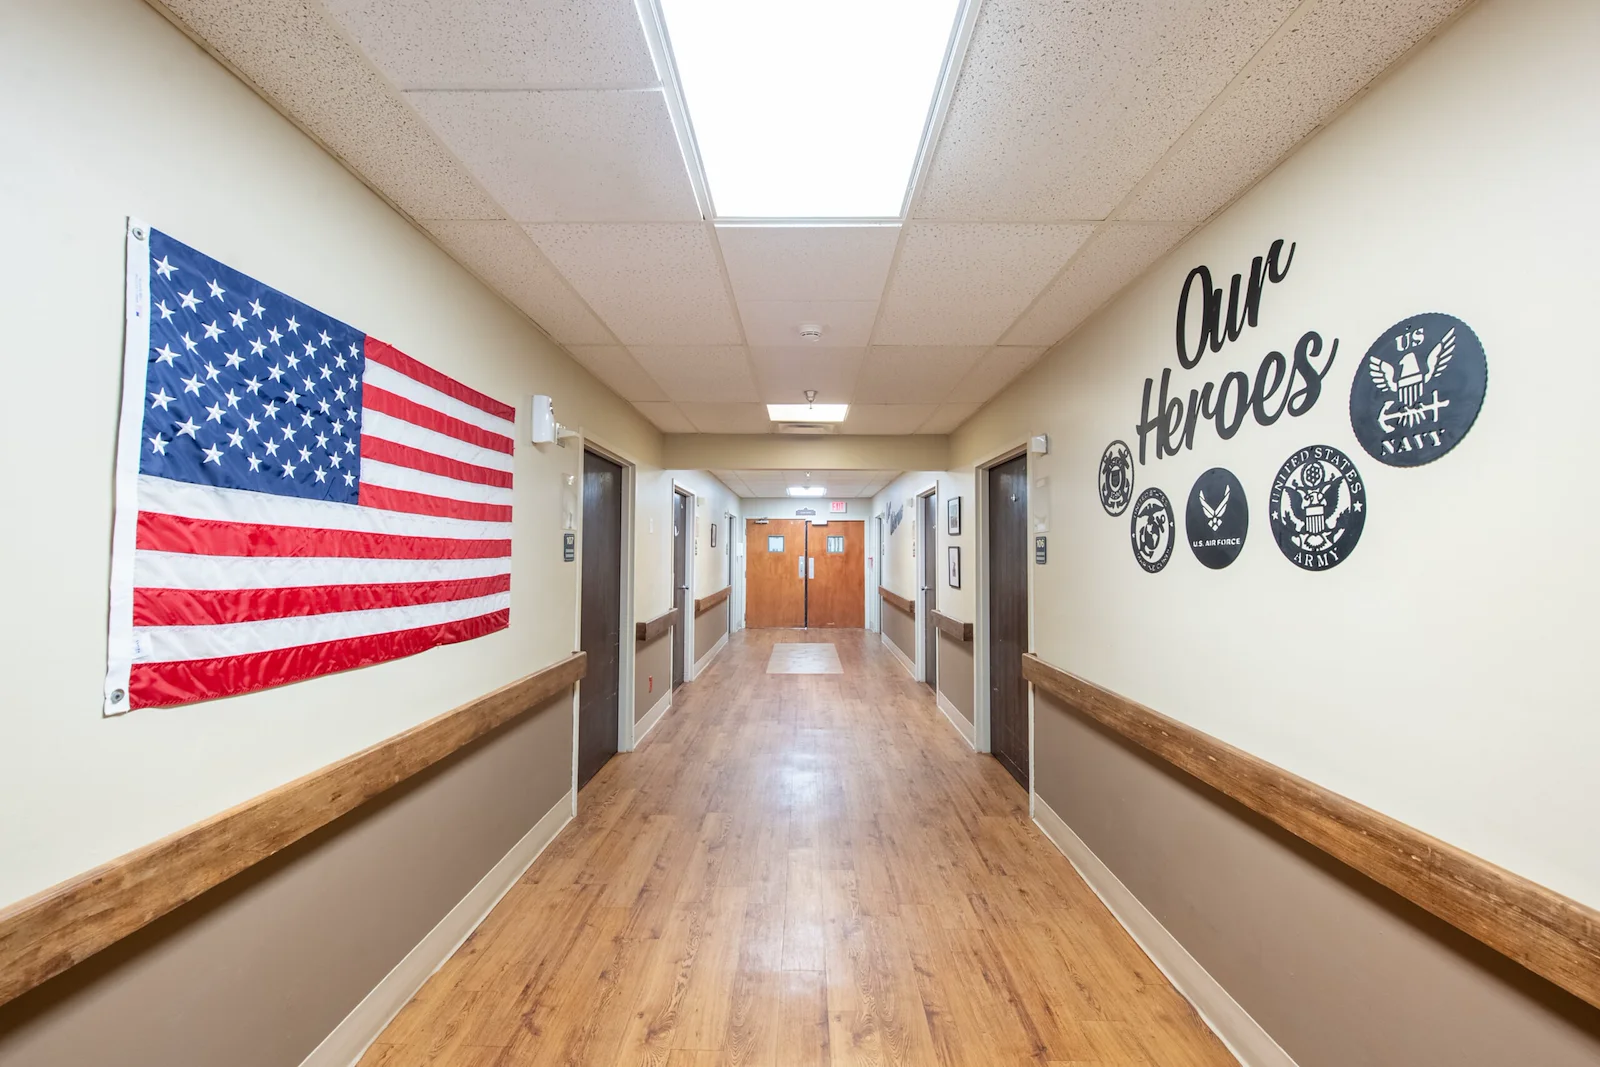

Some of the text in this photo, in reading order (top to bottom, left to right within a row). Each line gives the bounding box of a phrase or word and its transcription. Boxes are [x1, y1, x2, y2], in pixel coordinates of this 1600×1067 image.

[1176, 239, 1297, 370] Our
[1395, 327, 1425, 352] US
[1136, 331, 1340, 466] Heroes
[1381, 429, 1446, 456] NAVY
[1271, 447, 1362, 503] UNITED STATES
[832, 502, 844, 511] EXIT
[1192, 537, 1241, 548] U.S. AIR FORCE
[1293, 547, 1339, 568] ARMY
